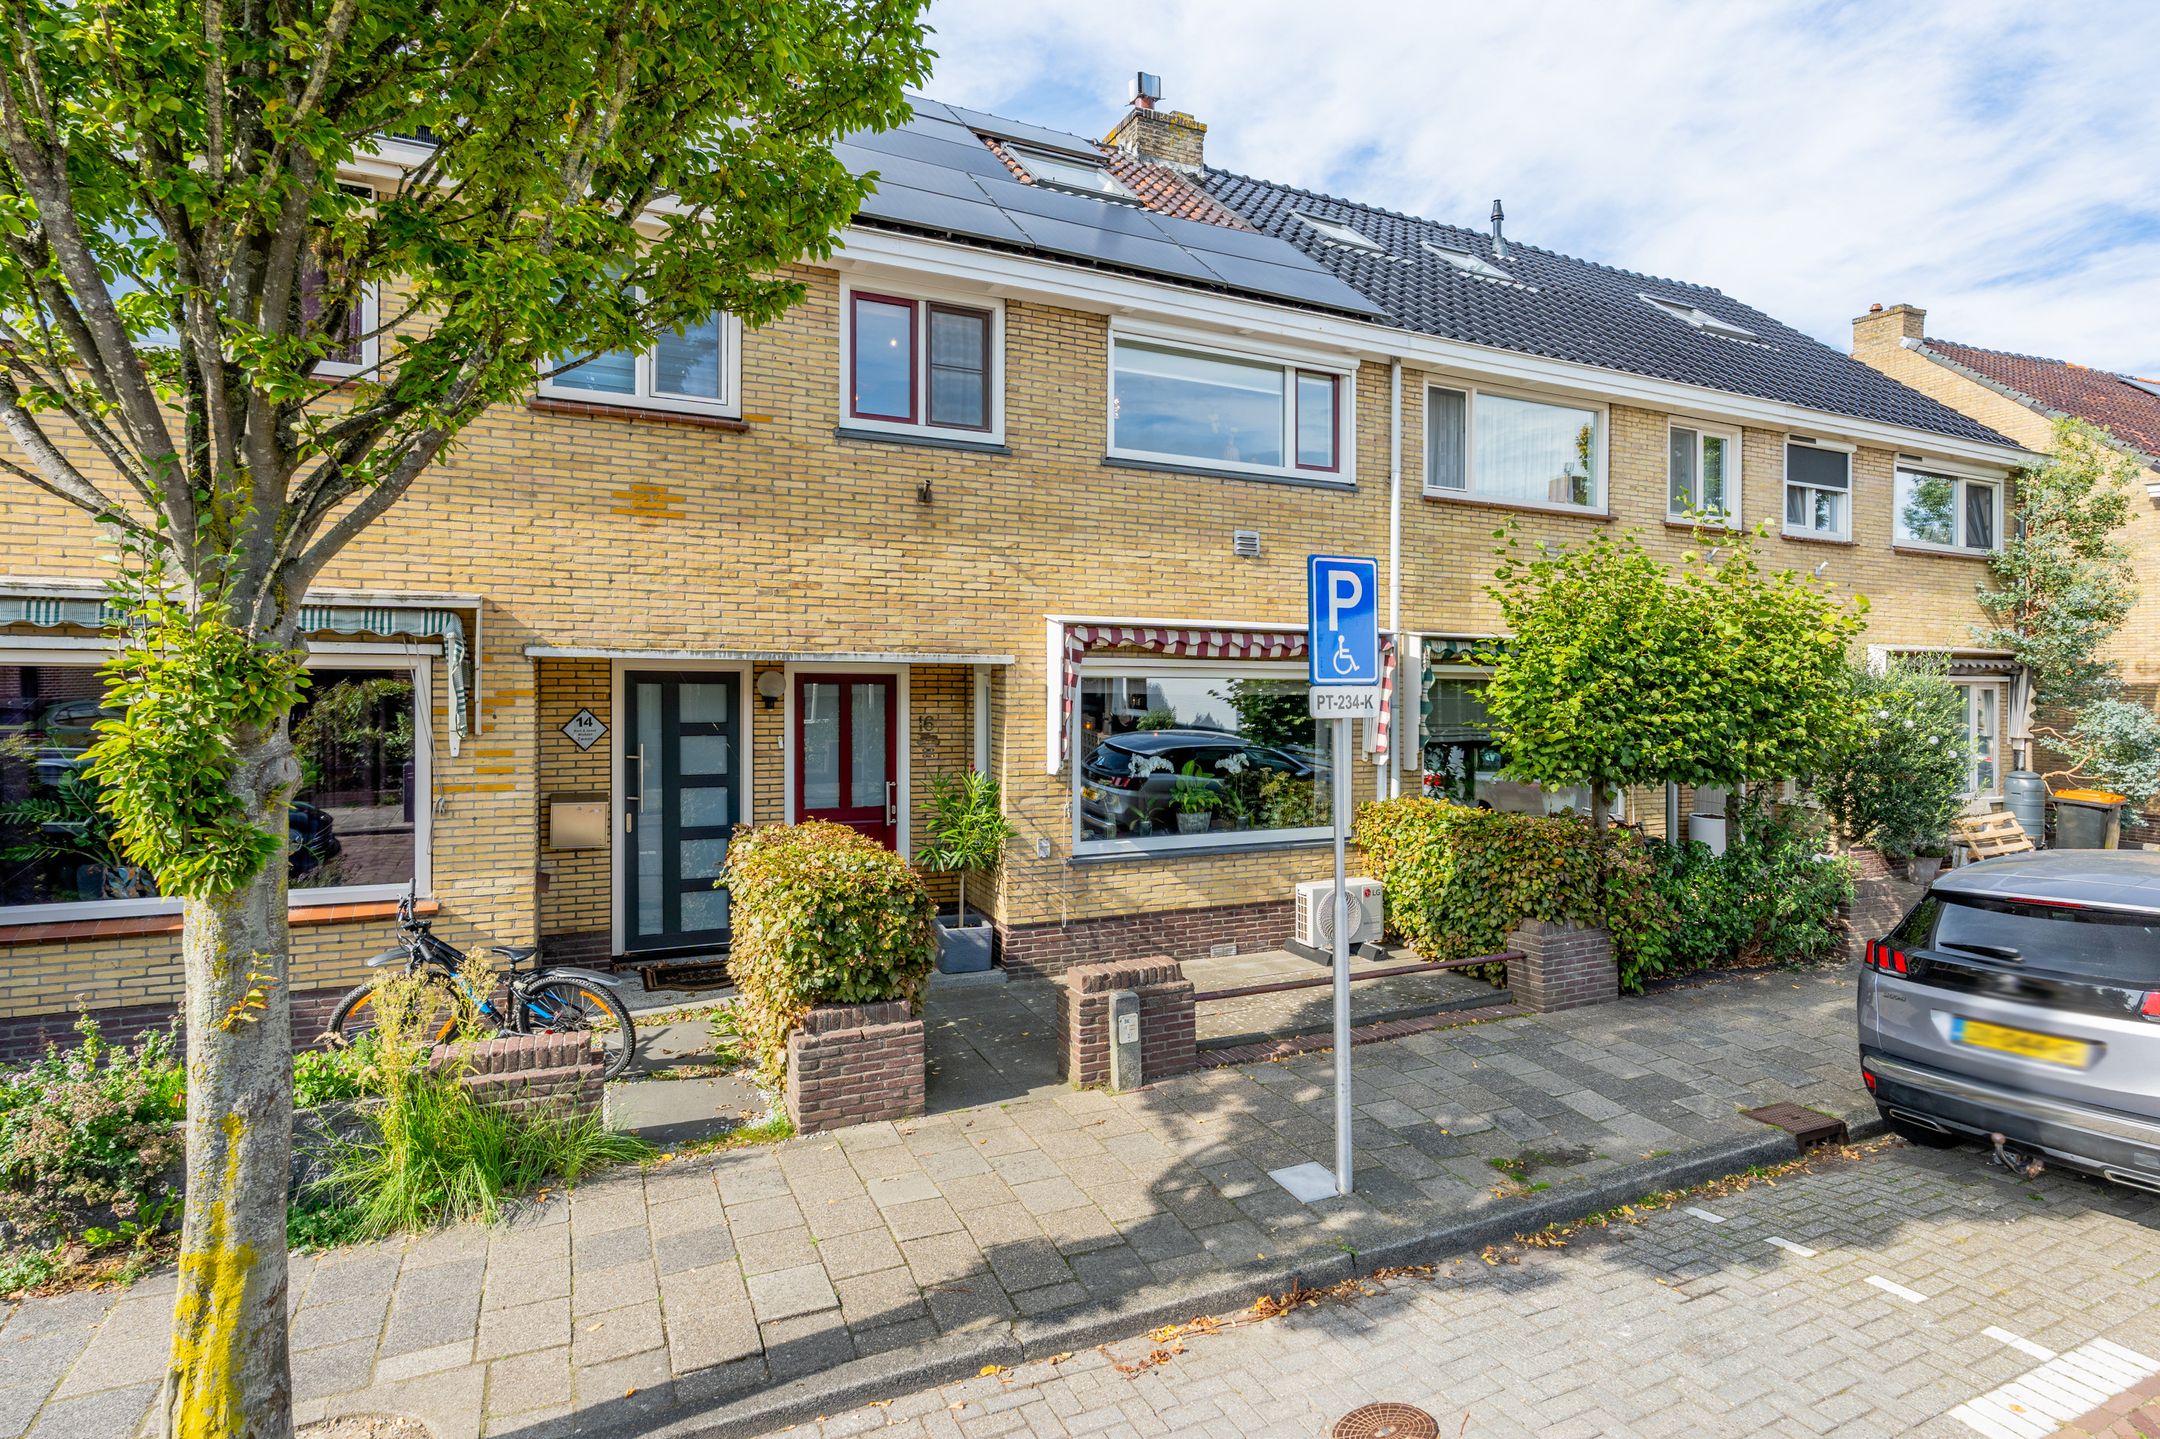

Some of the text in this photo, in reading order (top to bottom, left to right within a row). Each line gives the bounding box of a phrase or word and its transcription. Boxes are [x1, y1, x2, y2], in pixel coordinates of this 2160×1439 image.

[1328, 570, 1363, 631] P
[1317, 694, 1374, 710] PT-234-K
[576, 717, 593, 728] 14
